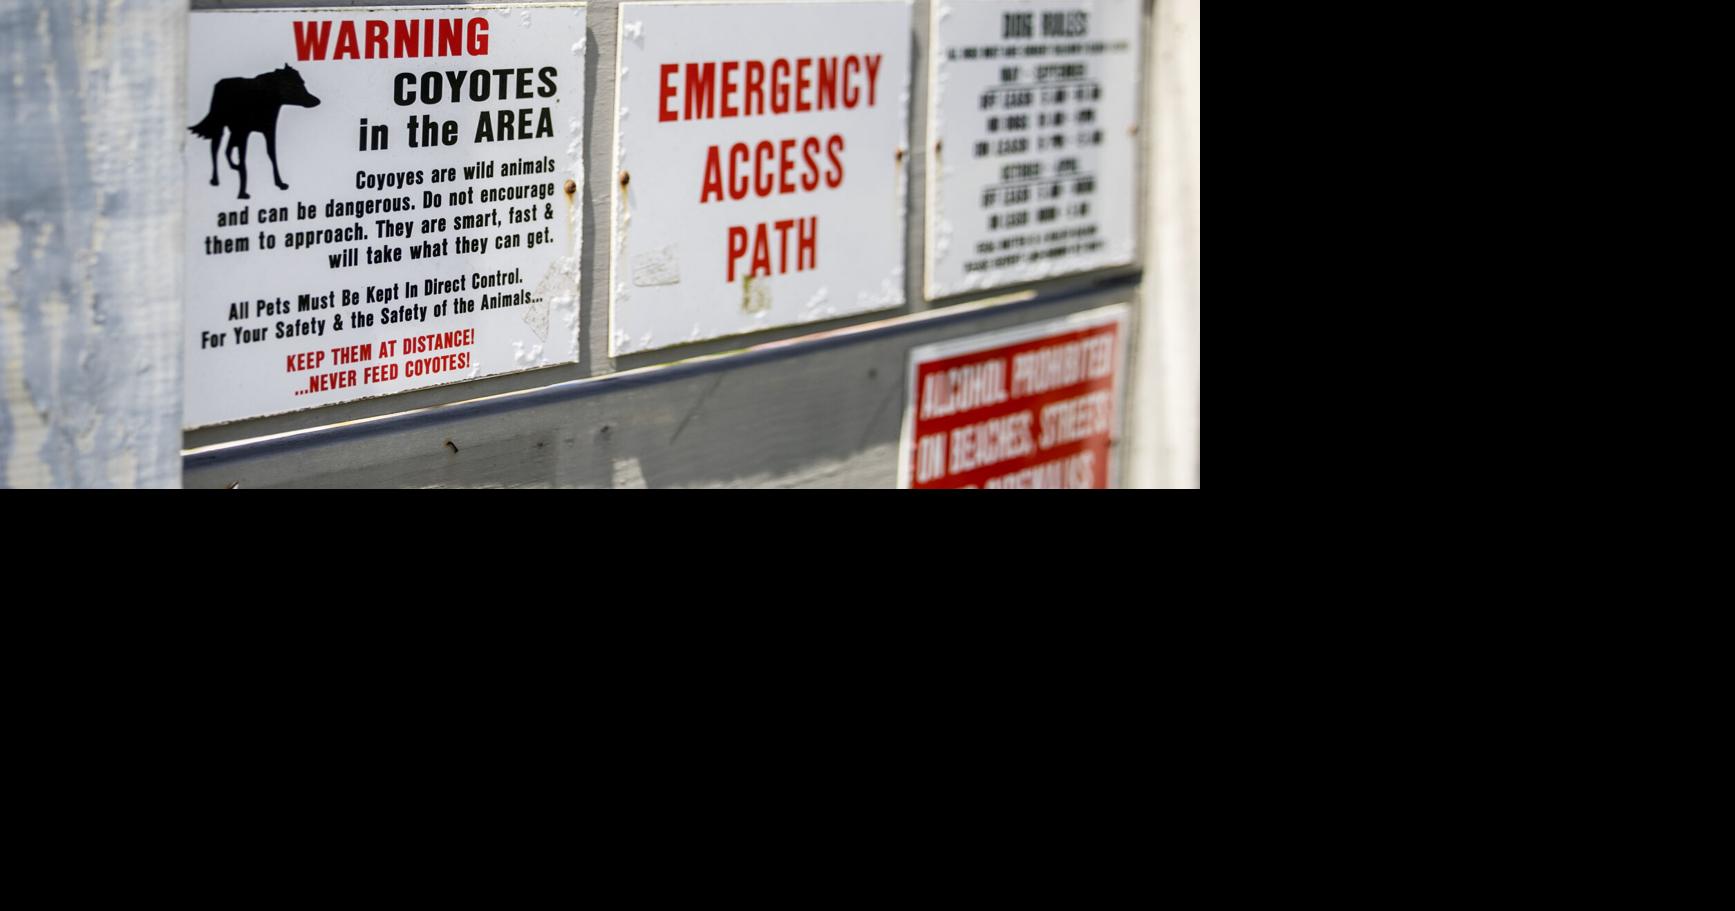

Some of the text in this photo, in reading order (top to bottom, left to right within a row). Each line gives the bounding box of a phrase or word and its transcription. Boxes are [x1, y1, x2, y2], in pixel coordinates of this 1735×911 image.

[293, 16, 490, 62] WARNING
[1003, 11, 1034, 39] DOG
[393, 66, 558, 107] COYOTES
[658, 54, 882, 123] EMERGENCY
[359, 106, 554, 152] in the AREA
[355, 155, 555, 191] Coyoyes are wild animals
[699, 134, 845, 205] ACCESS
[217, 182, 555, 228] and can be dangerous. Do not encourage
[204, 202, 554, 256] them to approach. They are smart, fast &
[328, 226, 554, 269] will take what they can get.
[727, 215, 818, 282] PATH
[228, 267, 523, 321] All Pets Must Be Kept In Direct Control.
[201, 330, 227, 350] For
[233, 326, 269, 345] Your
[275, 316, 326, 340] Safety
[332, 313, 344, 332] &
[350, 310, 374, 329] the
[380, 303, 428, 325] Safety
[433, 299, 448, 318] of
[453, 297, 475, 315] the
[286, 328, 475, 373] KEEP THEM AT DISTANCE!
[363, 363, 399, 385] FEED
[404, 351, 471, 379] COYOTES!
[920, 332, 1113, 421] ALCOHOL PROHIBITED
[916, 433, 947, 484] ON
